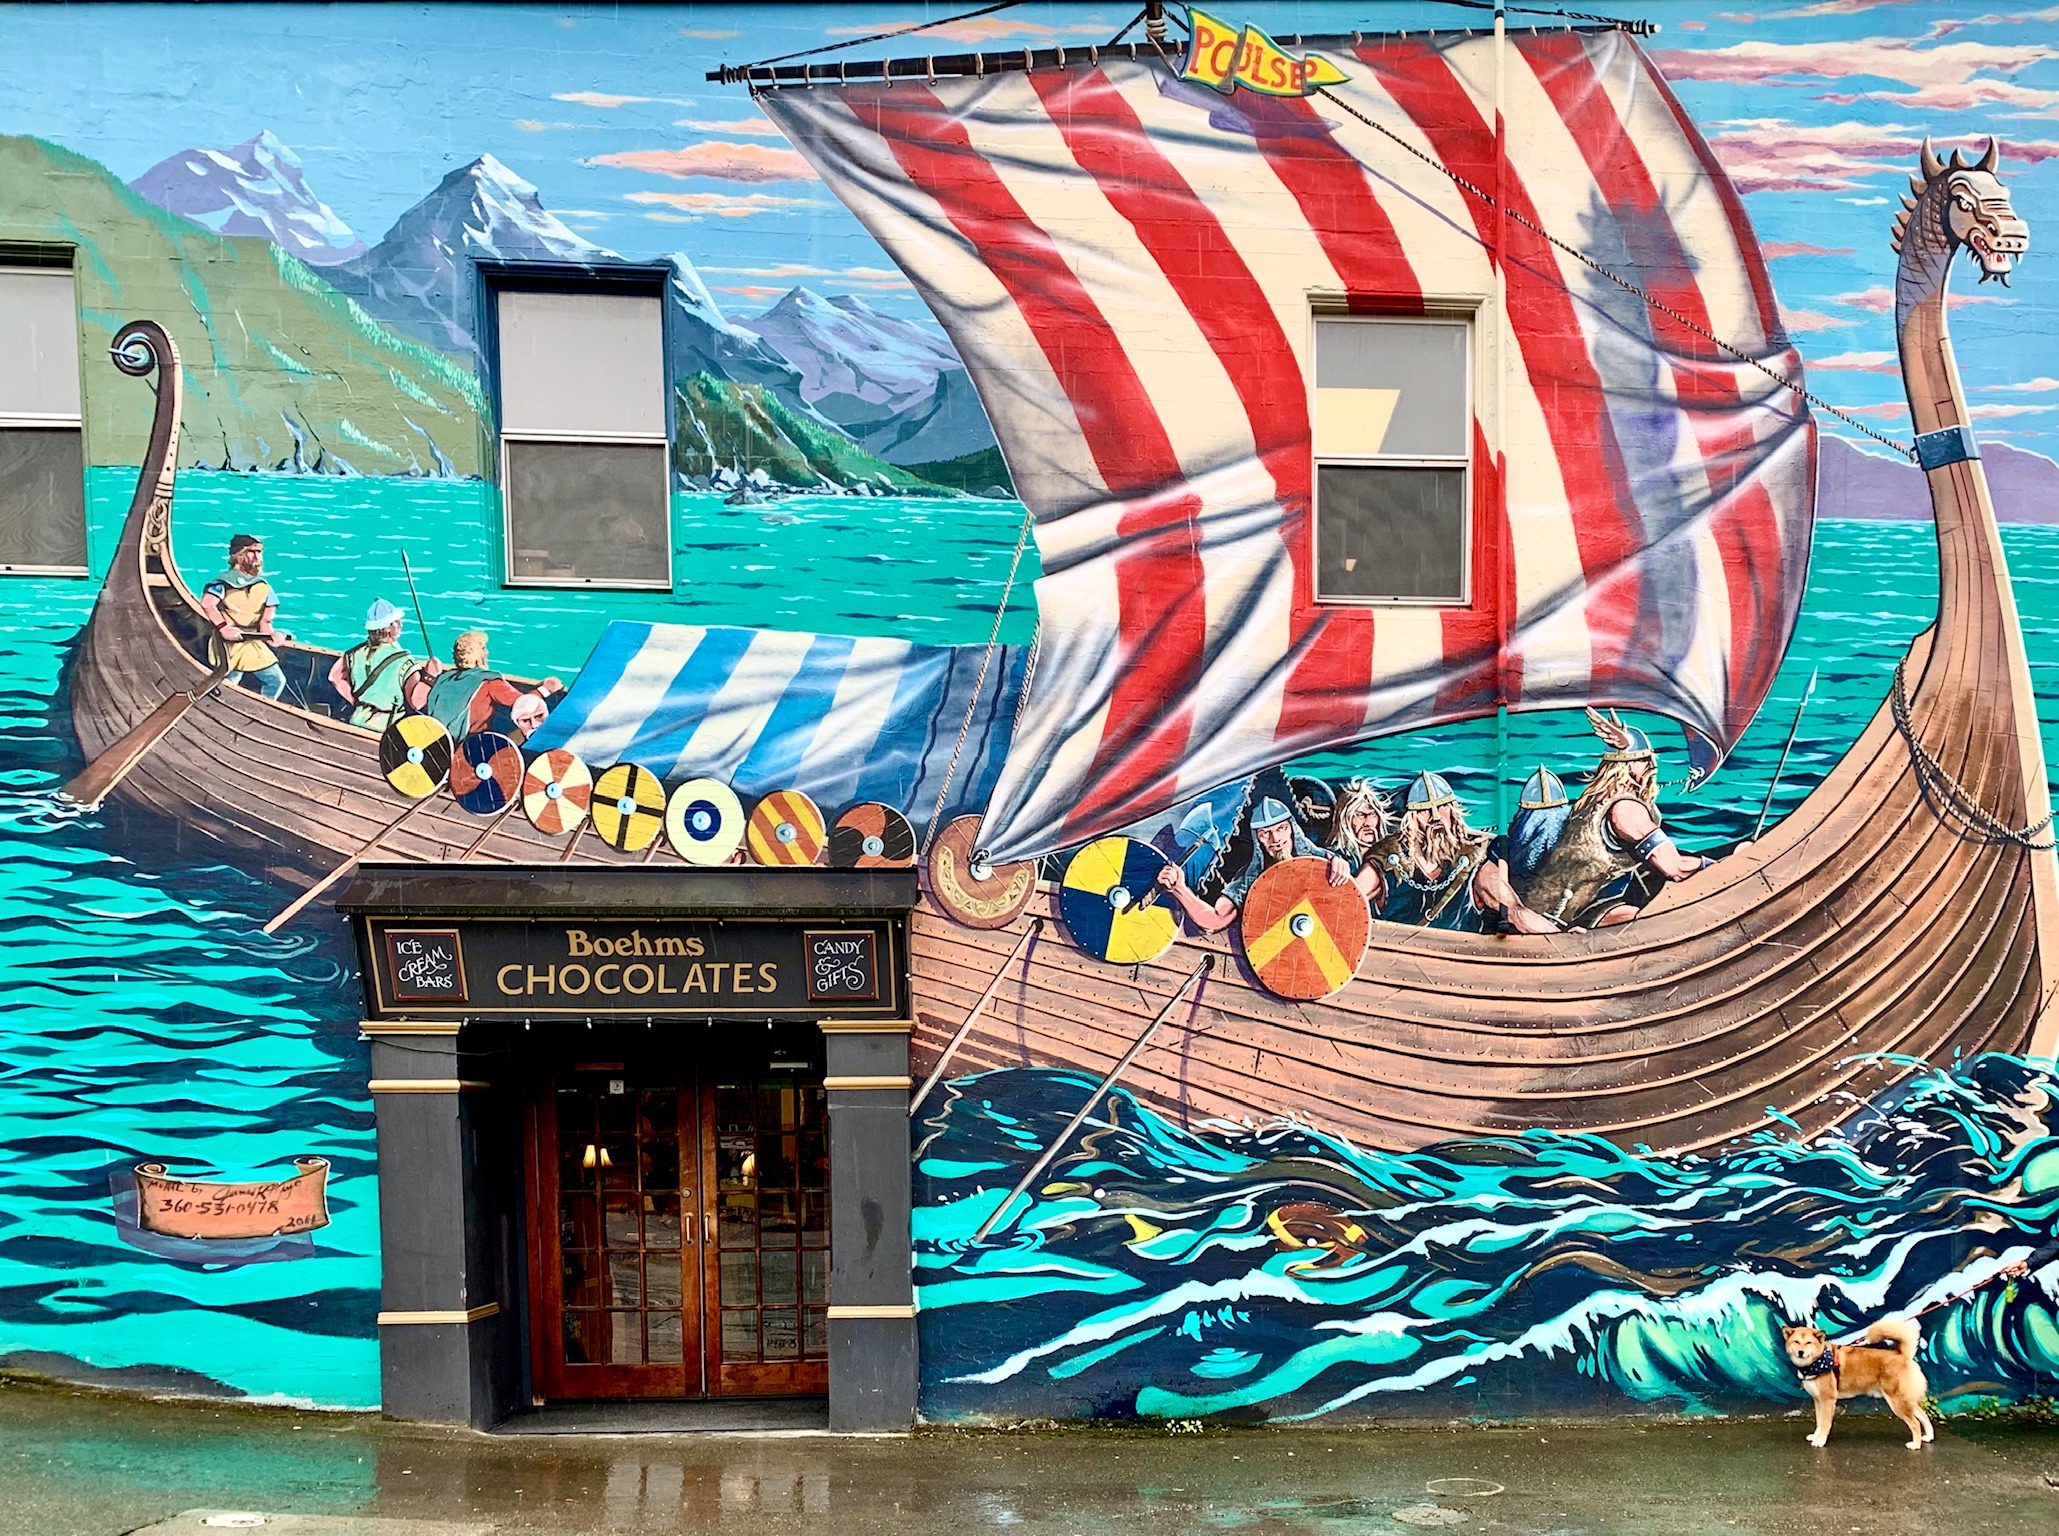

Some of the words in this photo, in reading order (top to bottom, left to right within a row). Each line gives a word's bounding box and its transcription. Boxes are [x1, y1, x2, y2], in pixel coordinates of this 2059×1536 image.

[396, 939, 422, 954] ICE
[565, 929, 705, 957] Boehms
[814, 939, 864, 955] CANDY
[398, 945, 453, 982] CREAM
[814, 956, 841, 976] &
[816, 955, 865, 992] GIFTS
[416, 974, 453, 988] BARS
[496, 963, 778, 996] CHOCOLATES
